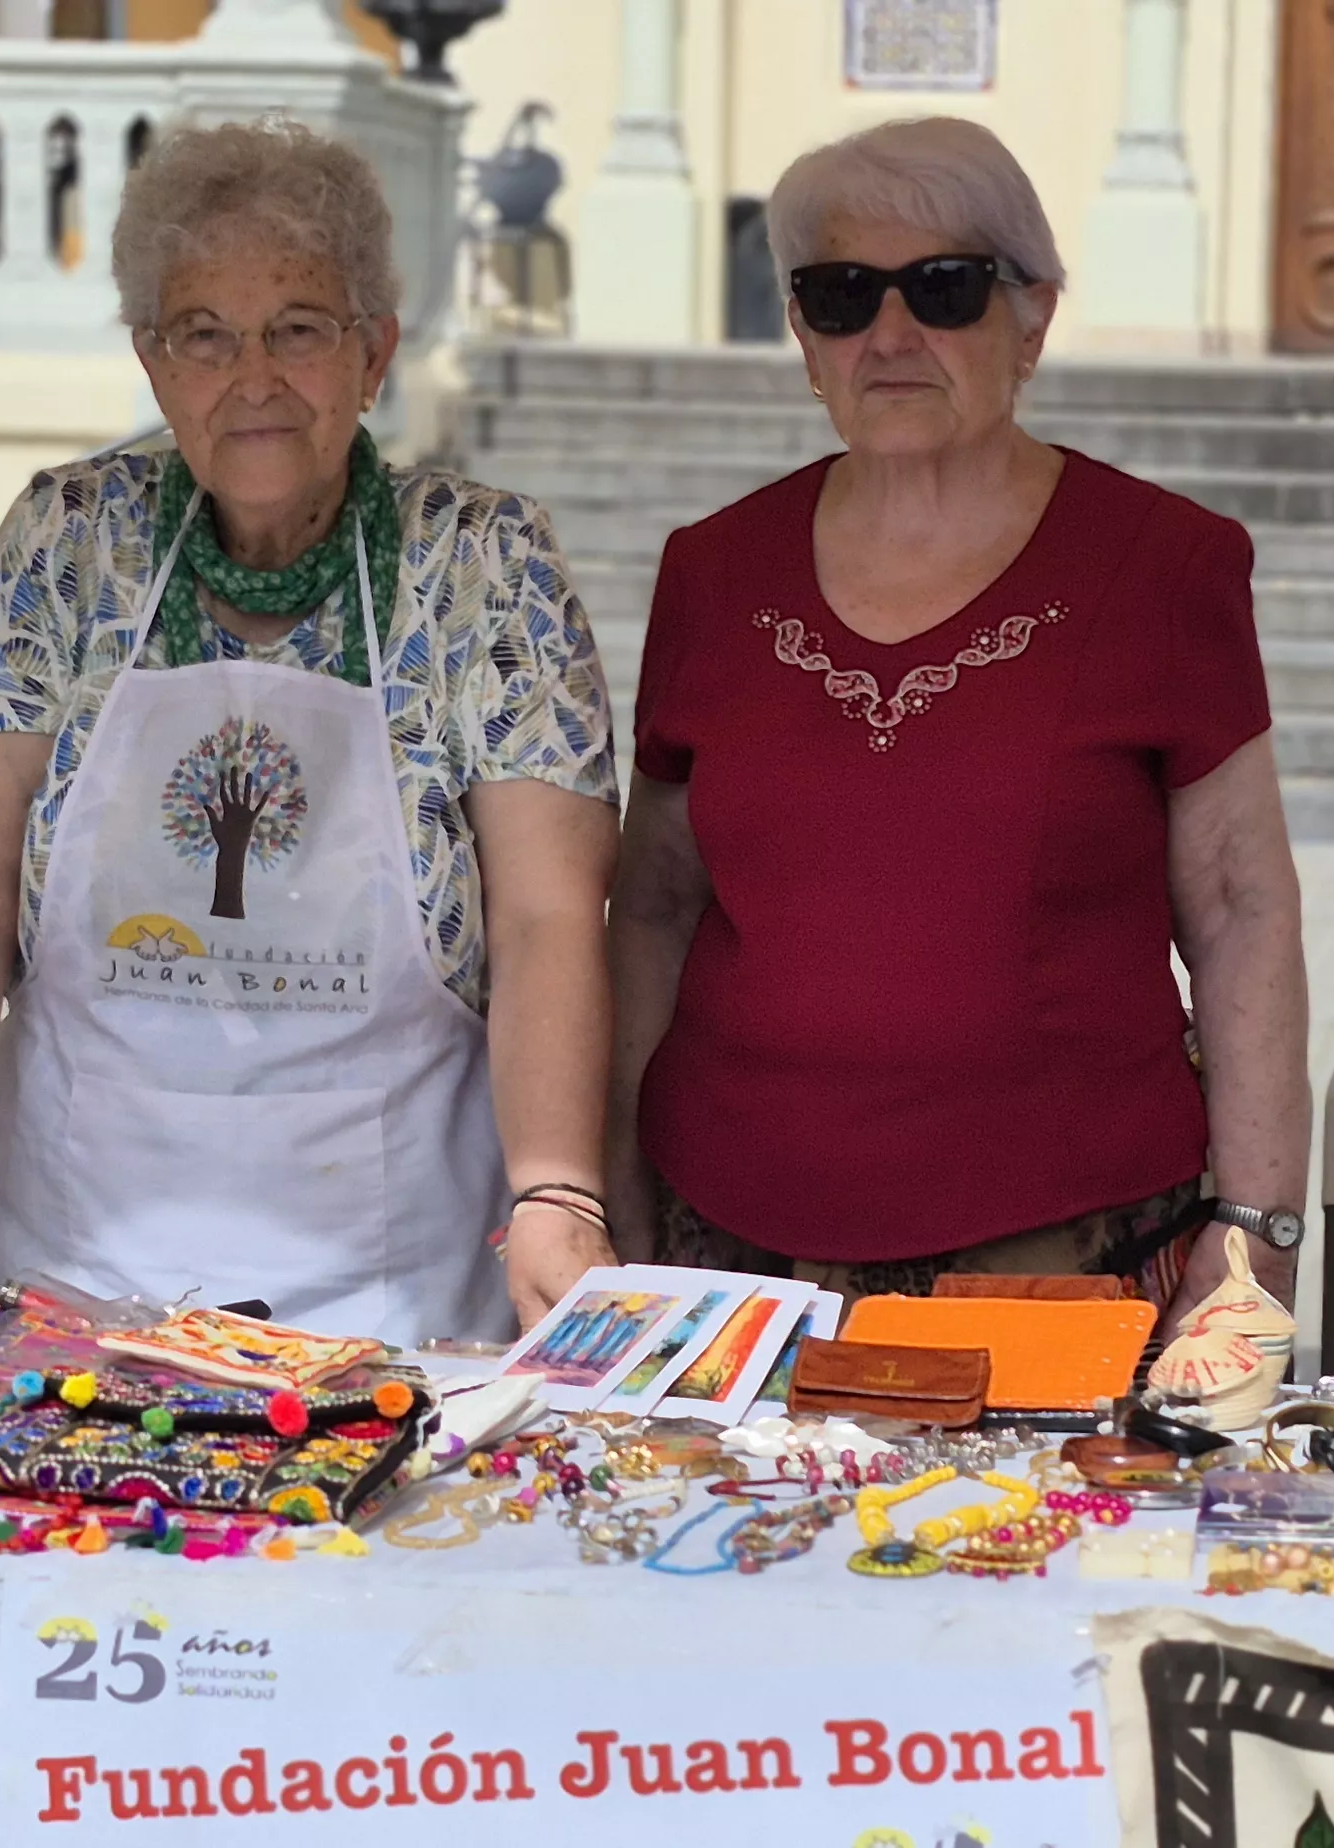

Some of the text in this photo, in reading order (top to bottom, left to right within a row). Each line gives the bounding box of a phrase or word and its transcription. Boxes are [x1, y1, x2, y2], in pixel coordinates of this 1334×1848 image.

[98, 959, 369, 994] Juan Bonal
[104, 986, 369, 1015] Hermanas de la Caridad de Santa Ana
[35, 1616, 272, 1703] 25 años
[174, 1658, 279, 1682] Sembrando
[177, 1681, 276, 1701] Solidaridad
[36, 1710, 1105, 1822] Fundación Juan Bonal
